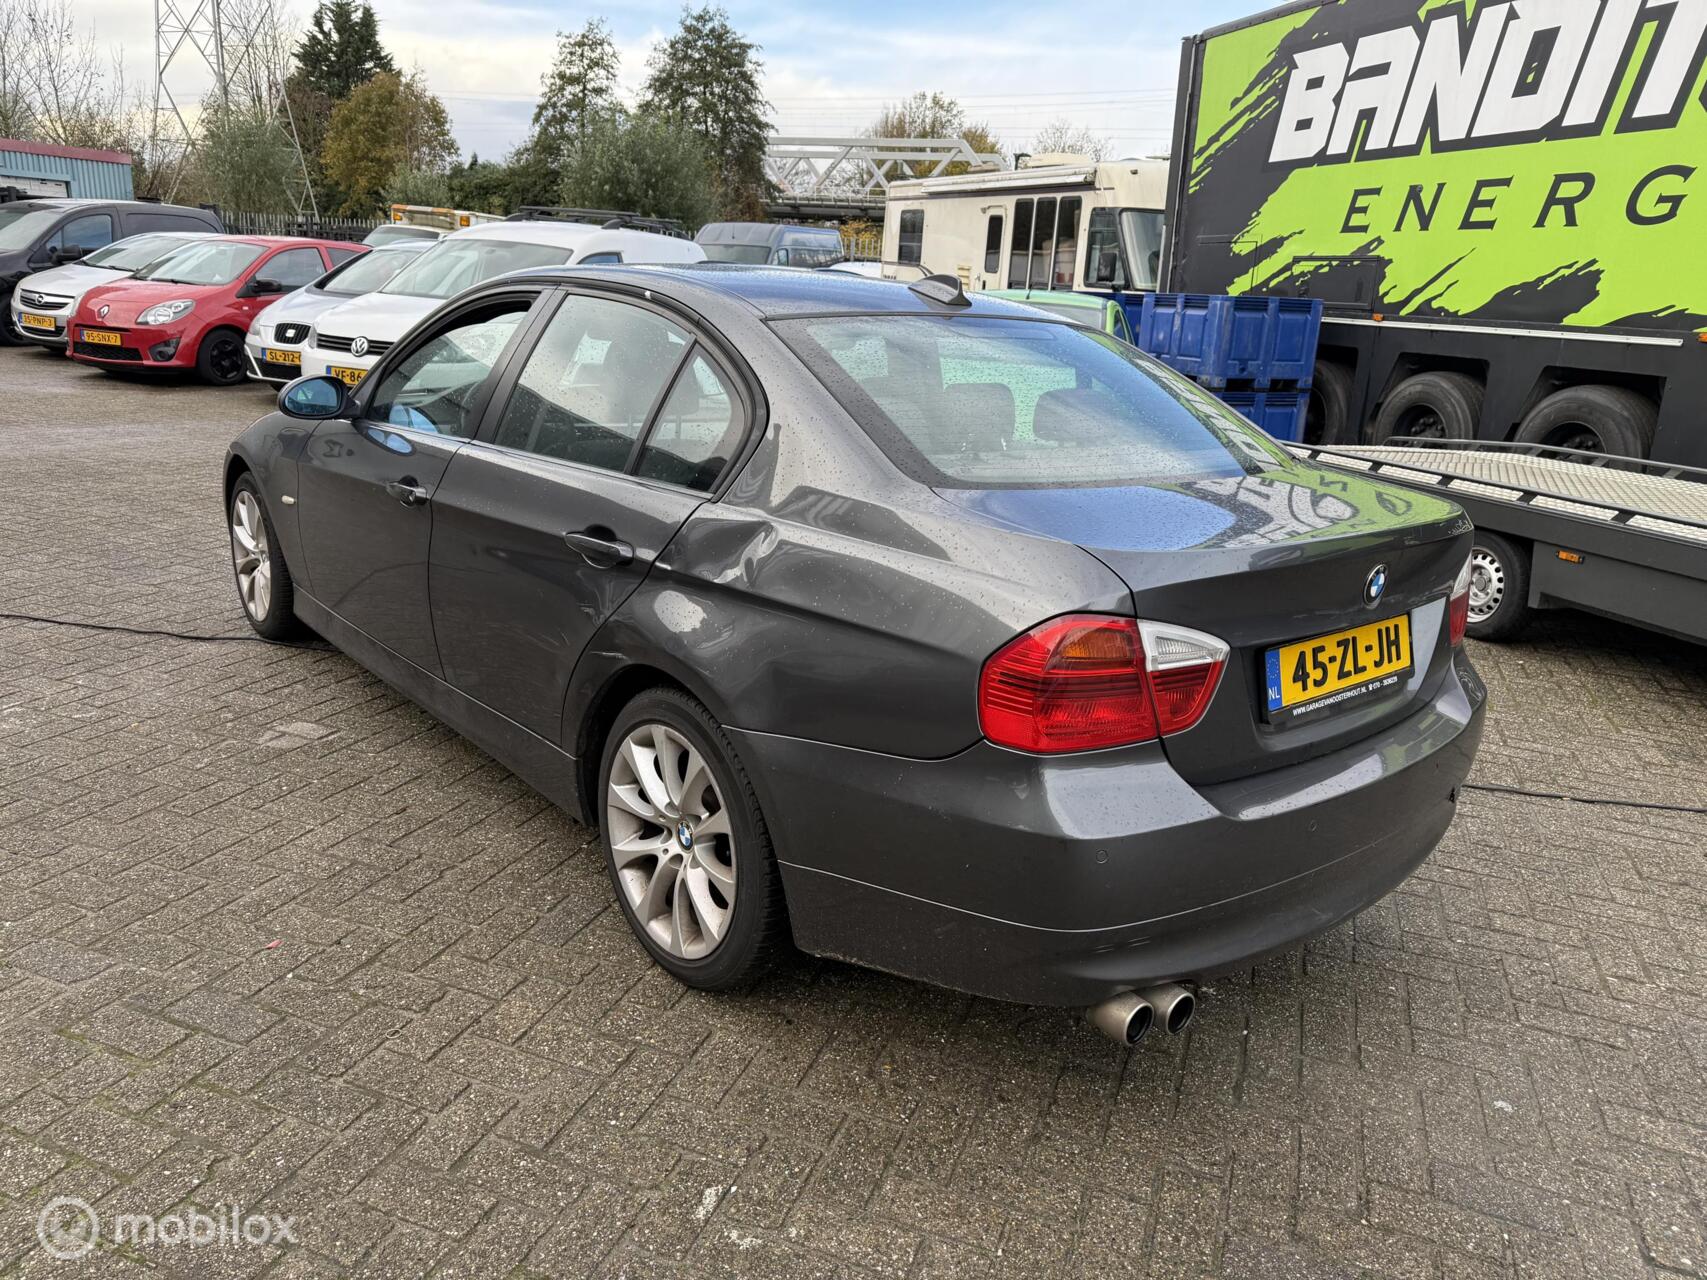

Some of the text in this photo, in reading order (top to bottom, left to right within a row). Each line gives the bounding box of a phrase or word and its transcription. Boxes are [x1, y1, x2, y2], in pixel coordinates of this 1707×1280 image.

[1340, 165, 1698, 234] ENERG
[85, 331, 118, 344] 95-SNX-7
[1292, 623, 1402, 692] 45-ZL-JH
[1268, 686, 1281, 699] NL
